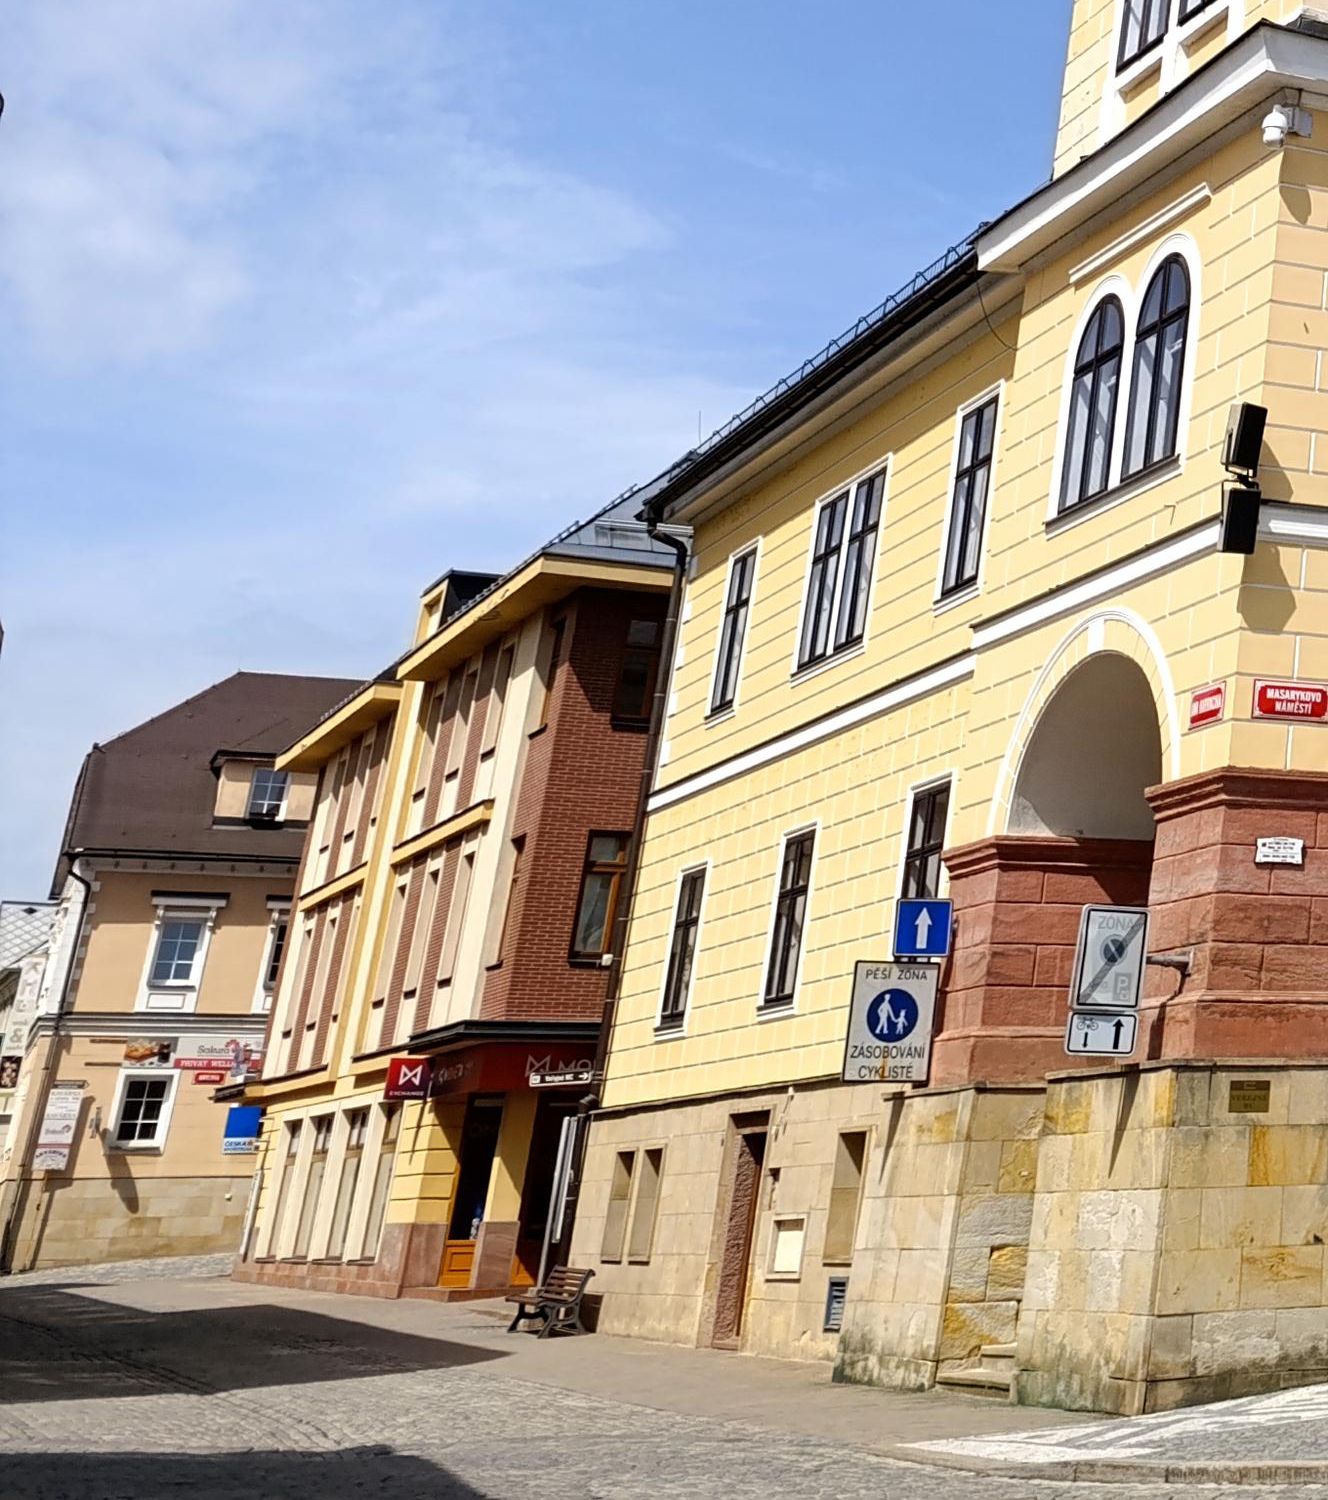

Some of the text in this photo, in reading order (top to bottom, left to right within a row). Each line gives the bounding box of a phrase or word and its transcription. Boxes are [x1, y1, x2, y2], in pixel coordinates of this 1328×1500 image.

[1266, 688, 1322, 702] MASARYKOVO
[1275, 701, 1312, 714] NÁMĚSTÍ
[866, 966, 928, 980] PĚŠÍ ZÓNA
[850, 1041, 926, 1059] ZÁSOBOVÁNÍ
[858, 1062, 913, 1079] CYKLISTÉ
